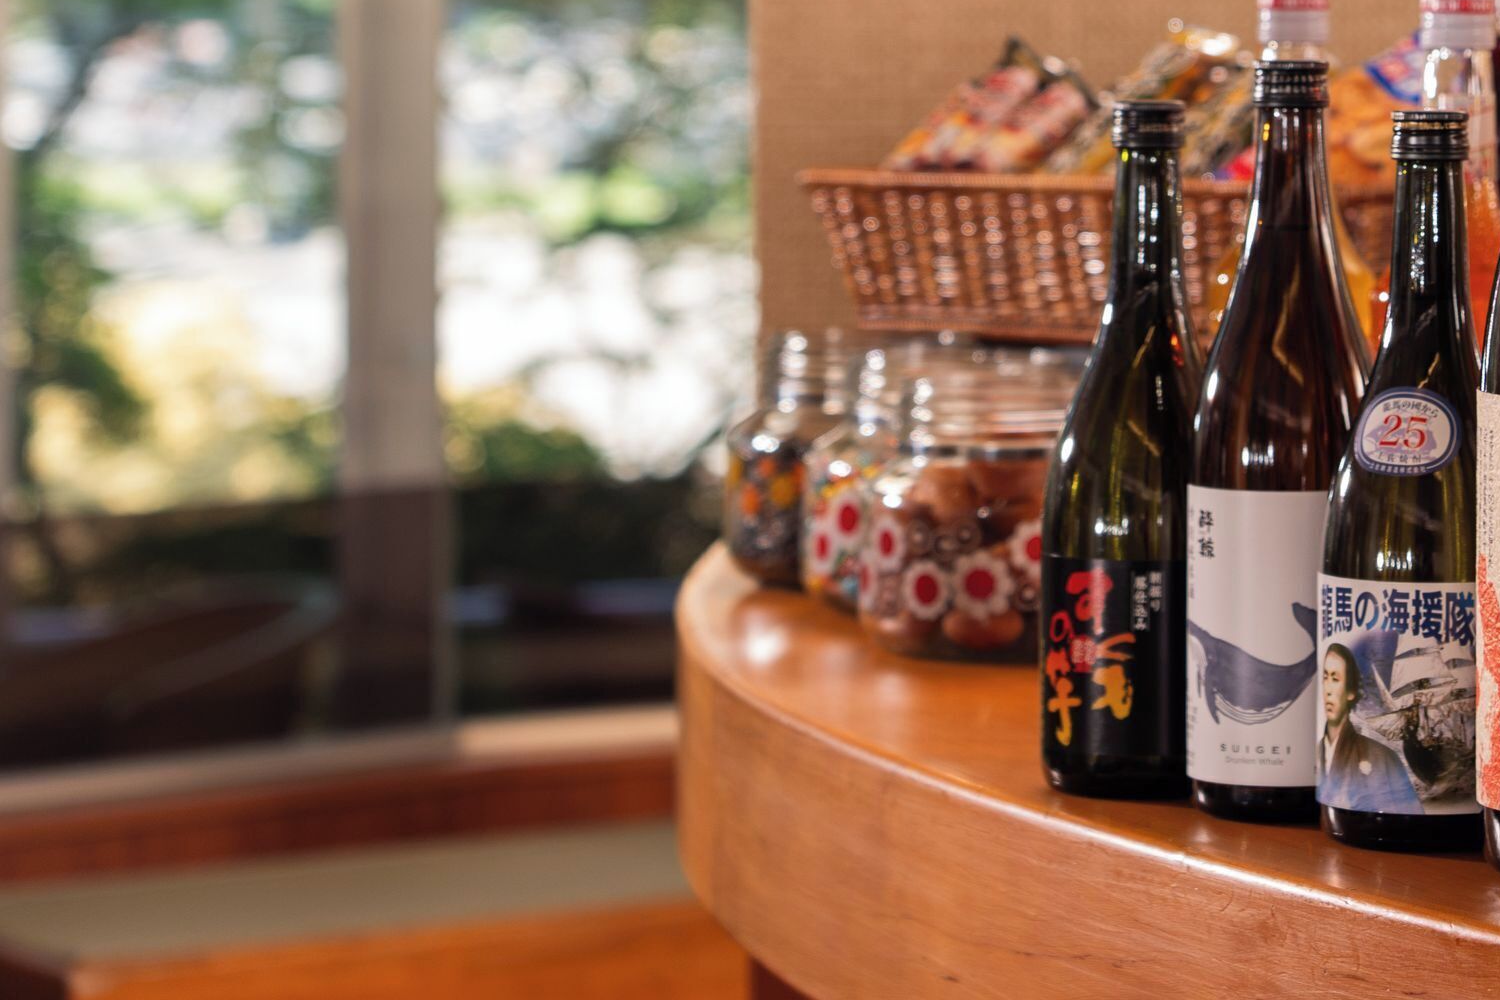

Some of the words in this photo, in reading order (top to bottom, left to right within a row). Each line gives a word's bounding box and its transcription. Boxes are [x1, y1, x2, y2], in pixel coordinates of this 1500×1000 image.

[1379, 414, 1427, 449] 25
[1322, 583, 1475, 646] 龍馬の海援隊
[1220, 743, 1291, 755] SUIGEI
